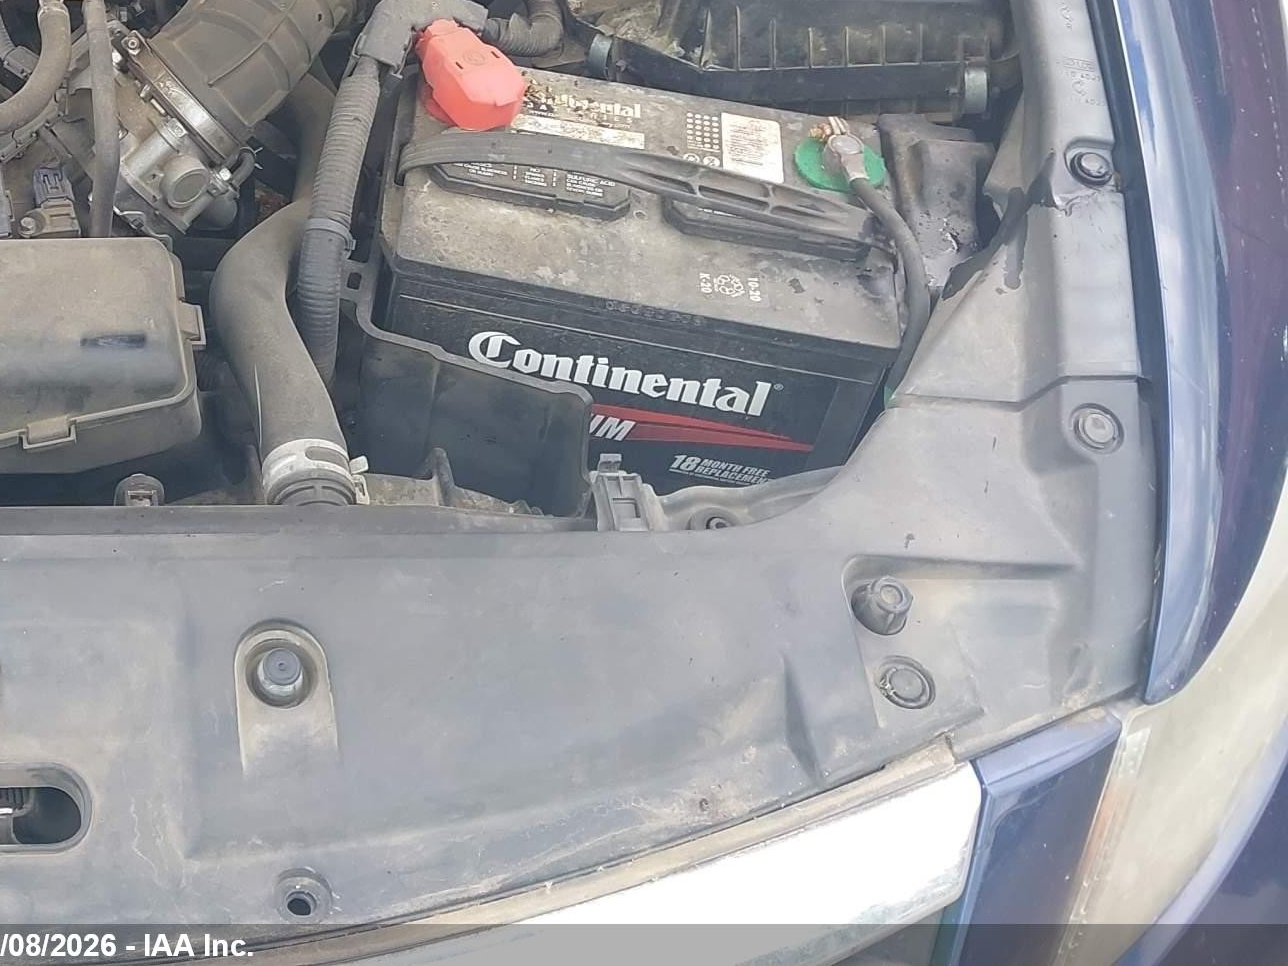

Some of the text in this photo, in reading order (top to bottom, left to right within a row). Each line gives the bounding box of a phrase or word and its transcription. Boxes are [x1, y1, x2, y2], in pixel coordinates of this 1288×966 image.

[468, 331, 772, 416] Continental
[670, 454, 772, 477] 18 MONTH FREE
[694, 465, 769, 485] REPLACEMEN
